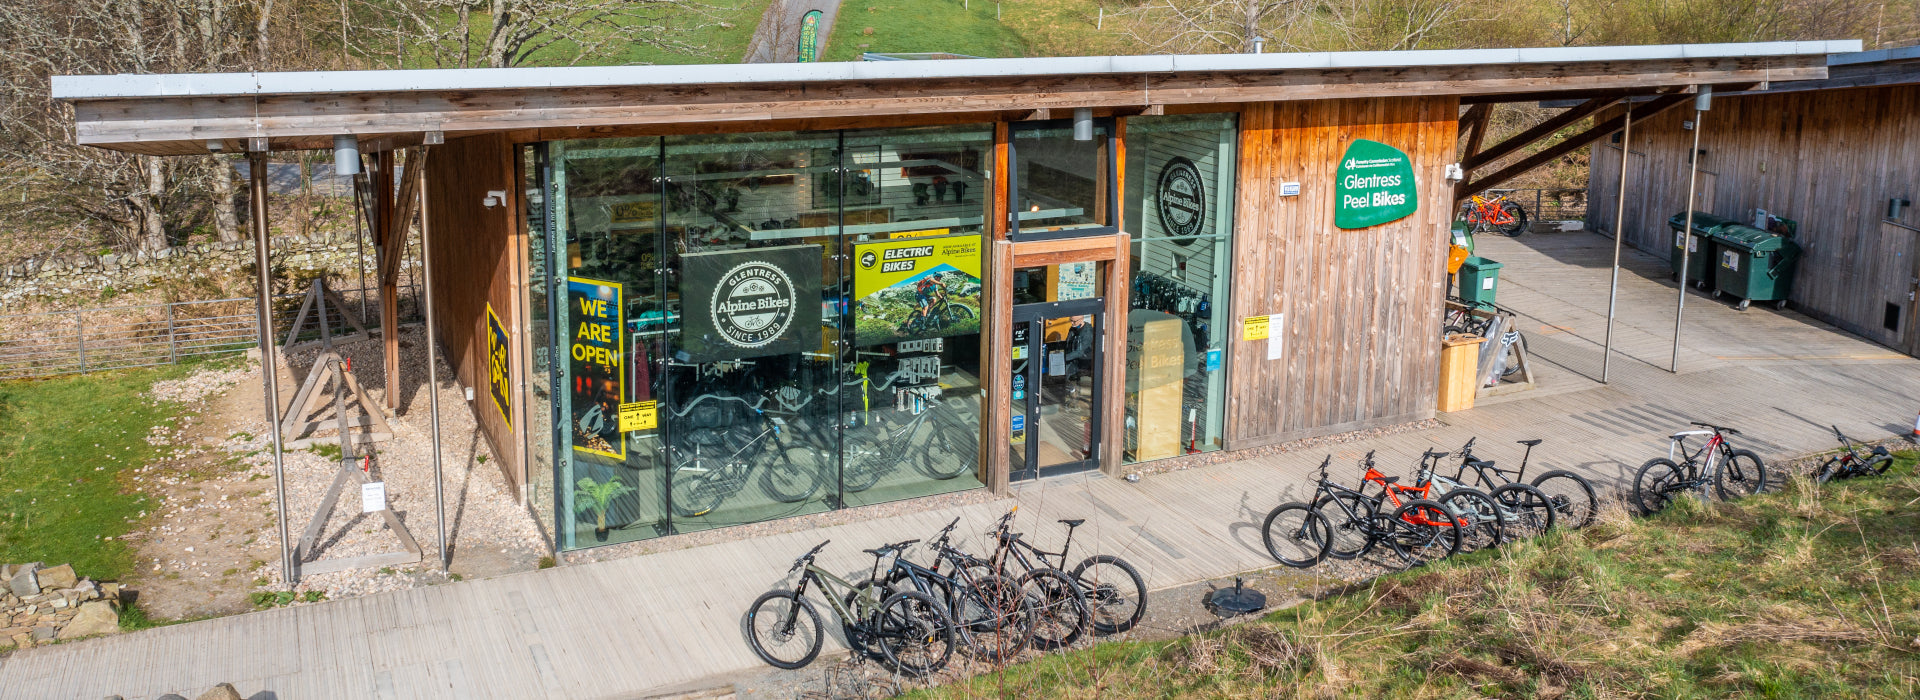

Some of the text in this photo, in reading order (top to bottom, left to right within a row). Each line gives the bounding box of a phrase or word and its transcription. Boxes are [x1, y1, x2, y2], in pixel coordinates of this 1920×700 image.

[802, 25, 811, 63] LENTRESS
[1344, 173, 1401, 189] Glentress
[1163, 191, 1200, 212] Alpine Bikes
[1343, 190, 1405, 209] Peel Bikes
[884, 246, 933, 260] ELECTRIC
[942, 248, 961, 256] Alpine
[529, 237, 547, 294] Alpine
[882, 260, 914, 272] BIKES
[728, 268, 781, 287] GLENTRESS
[579, 297, 608, 318] WE
[717, 297, 789, 315] Alpine Bikes
[577, 321, 611, 343] ARE
[726, 322, 781, 342] SINCE 1989
[571, 343, 618, 367] OPEN
